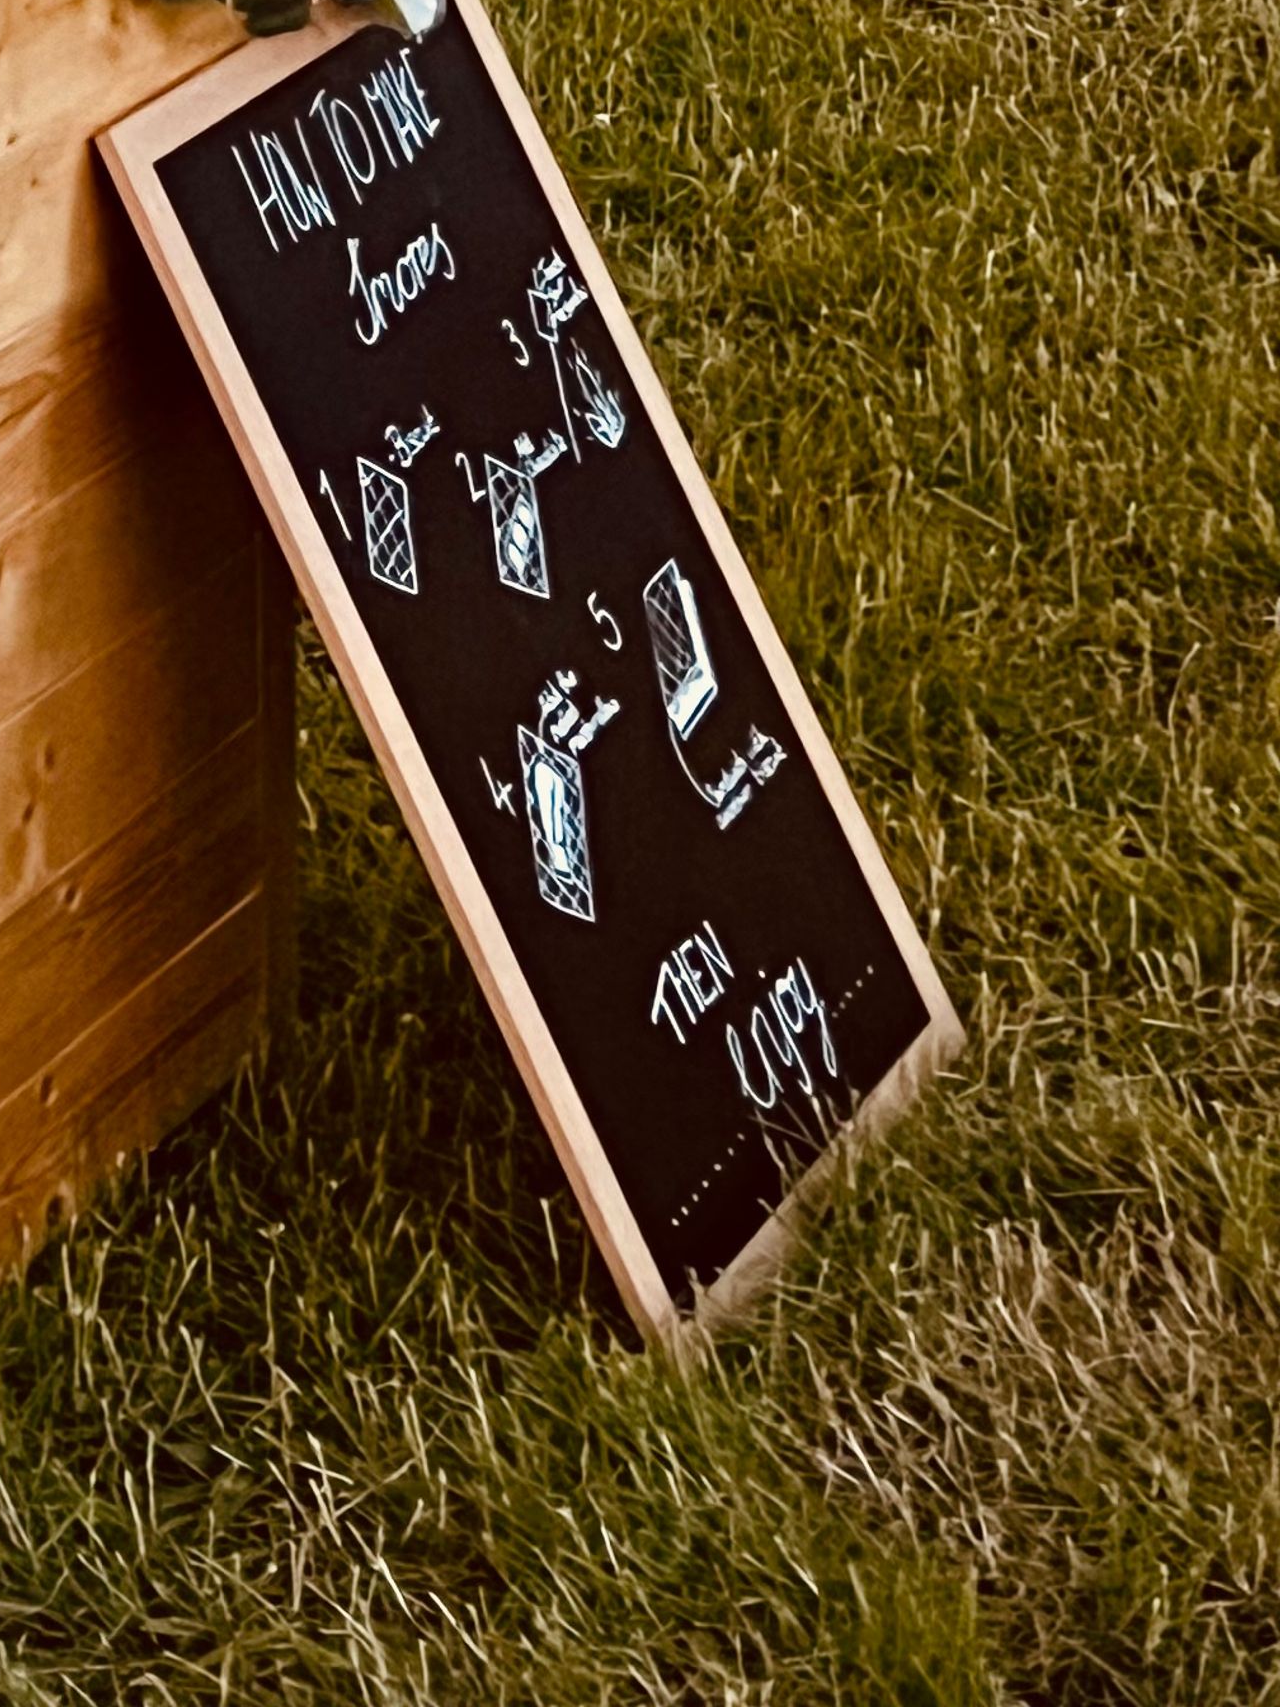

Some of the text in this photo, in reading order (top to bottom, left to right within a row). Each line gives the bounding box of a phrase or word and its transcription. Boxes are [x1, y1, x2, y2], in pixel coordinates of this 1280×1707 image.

[230, 47, 441, 253] HOW TO MAKE
[501, 318, 530, 367] 3
[319, 468, 352, 541] 1
[455, 452, 486, 503] 2
[587, 591, 623, 651] 5
[479, 755, 517, 818] 4
[651, 920, 735, 1044] THEN
